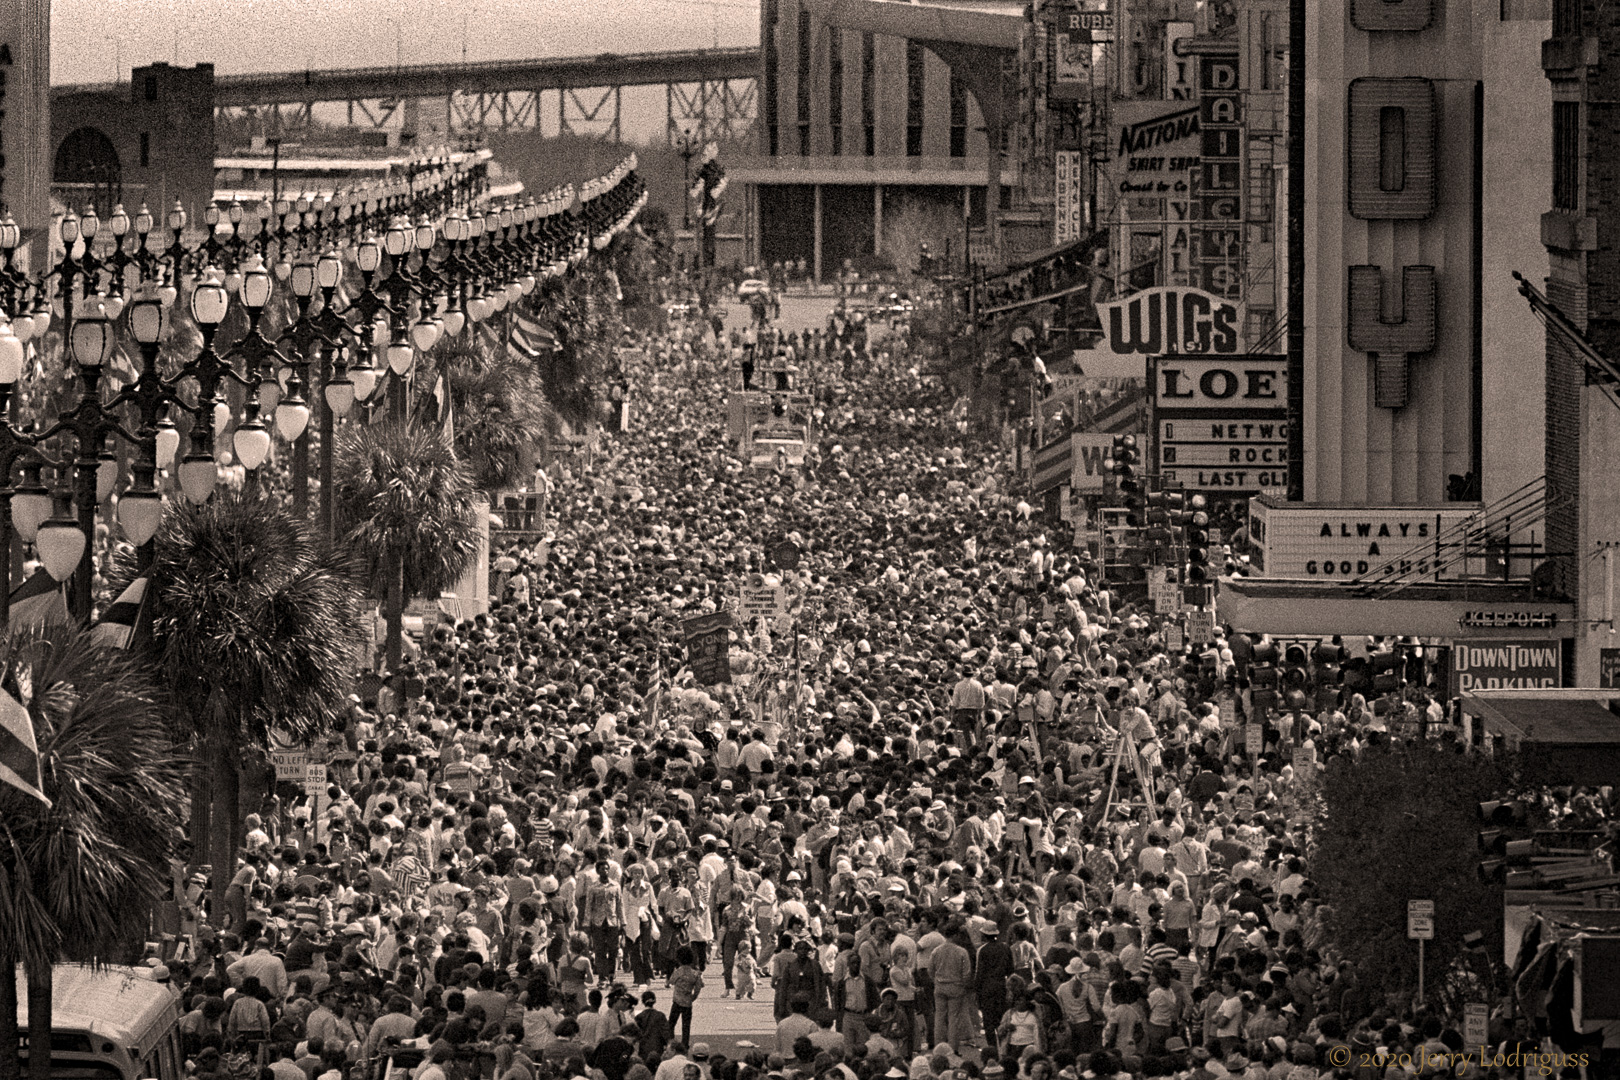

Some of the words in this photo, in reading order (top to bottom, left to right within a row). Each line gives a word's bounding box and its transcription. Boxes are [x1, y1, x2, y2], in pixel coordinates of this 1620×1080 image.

[1110, 291, 1238, 354] WIGS
[1162, 369, 1288, 399] LOE
[1199, 472, 1247, 486] LAST
[1320, 523, 1428, 537] ALWAYS
[1368, 542, 1381, 556] A
[1306, 561, 1369, 575] GOOD
[1470, 611, 1515, 627] KEEP
[1455, 645, 1557, 671] DOWNTOWN
[1460, 673, 1554, 692] PARKING
[272, 756, 285, 764] NO
[287, 757, 307, 765] LEFT
[279, 766, 300, 775] TURN
[1467, 1028, 1485, 1037] TIME
